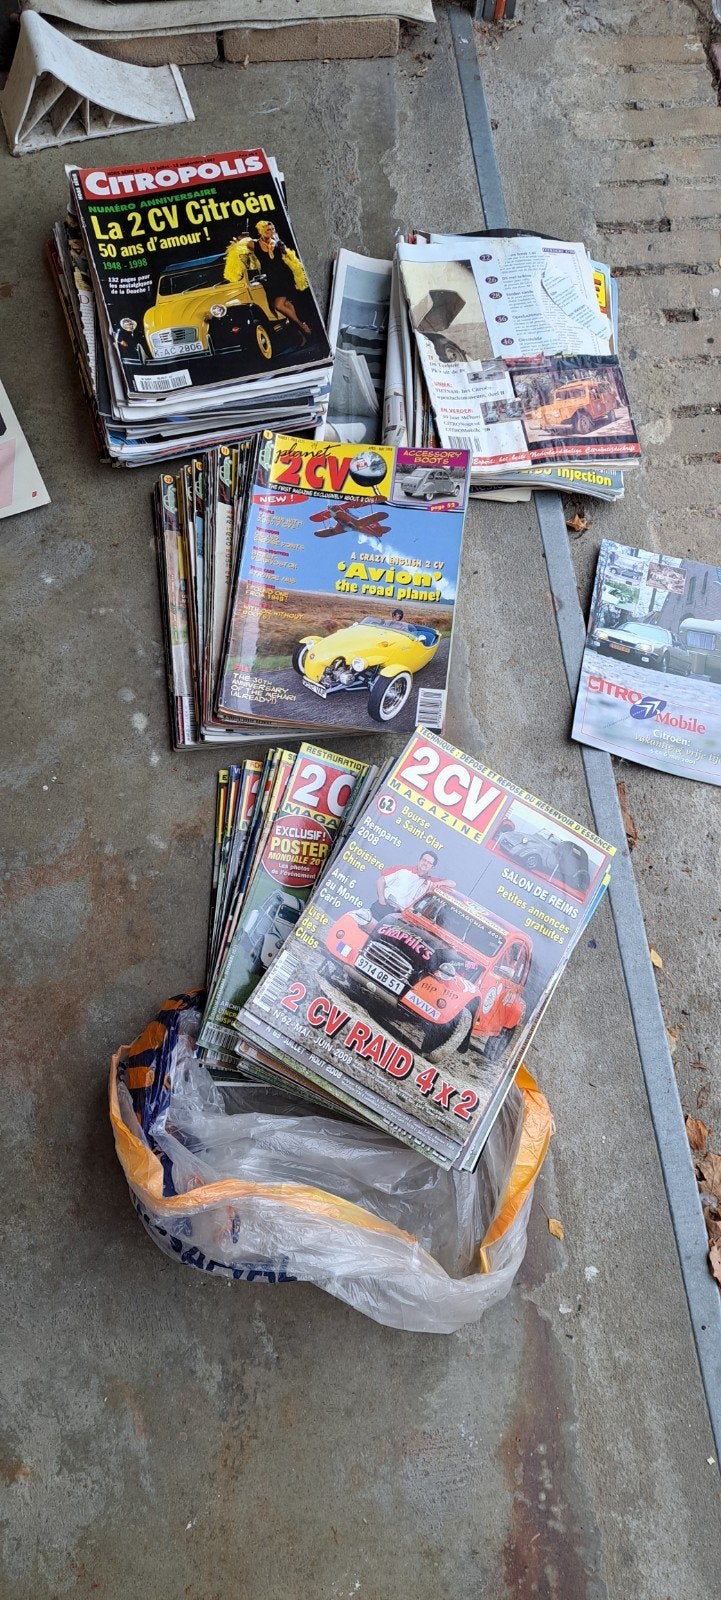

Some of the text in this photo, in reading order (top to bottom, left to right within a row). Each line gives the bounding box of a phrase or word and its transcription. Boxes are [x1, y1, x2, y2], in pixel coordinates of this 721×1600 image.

[85, 156, 263, 196] CITROPOLIS
[88, 188, 217, 213] NUMÉRO ANNIVERSAIRE
[90, 192, 275, 240] La 2 CV Citroën
[98, 243, 117, 258] 50
[120, 244, 145, 257] ans
[147, 232, 201, 252] d'amour
[102, 258, 148, 270] 1948 1998
[118, 280, 153, 289] nostalgiques
[120, 276, 136, 284] pages
[138, 274, 150, 282] pour
[126, 287, 146, 295] Douche
[180, 342, 202, 353] 2806
[274, 443, 341, 464] planet
[403, 450, 462, 459] ACCESSORY
[275, 455, 354, 492] 2CV
[350, 552, 444, 569] A CRAZY ENGLISH 2 CV
[335, 579, 442, 602] the road plane!
[231, 680, 289, 693] ANNIVERSARY
[233, 672, 250, 680] THE
[246, 687, 264, 696] THE
[588, 675, 643, 704] CITRO
[656, 712, 706, 734] Mobile
[653, 728, 690, 747] Citroën:
[400, 746, 501, 822] 2CV
[419, 726, 612, 852] TECHNIQUE DEPOSE ET REPOSE DU RESERVOIR D'ESSENCE
[379, 797, 394, 812] 62
[390, 779, 482, 842] MAGAZINE
[284, 803, 339, 829] MAGA
[402, 805, 431, 829] Bourse
[357, 827, 380, 846] 2008
[363, 816, 402, 848] Remparts
[270, 837, 329, 858] POSTER
[268, 852, 324, 866] MONDIALE 20
[290, 864, 310, 872] photos
[342, 851, 366, 872] Chine
[331, 867, 357, 889] Ami 6
[319, 888, 341, 908] Carlo
[325, 879, 364, 908] au Monte
[501, 867, 579, 919] SALON DE REIMS
[307, 905, 329, 925] Liste
[496, 885, 527, 909] Petites
[528, 906, 570, 935] annonces
[301, 917, 317, 932] des
[524, 917, 564, 945] gratuites
[295, 927, 319, 949] Clubs
[388, 979, 401, 992] 51
[220, 1000, 241, 1011] ARCHI
[408, 995, 437, 1018] AVIVA
[215, 1015, 233, 1026] SUSP
[280, 982, 307, 1013] 2
[306, 997, 349, 1036] CV
[344, 1020, 414, 1078] RAID
[415, 1066, 438, 1095] 4
[452, 1089, 478, 1121] 2
[313, 1037, 334, 1052] JUIN
